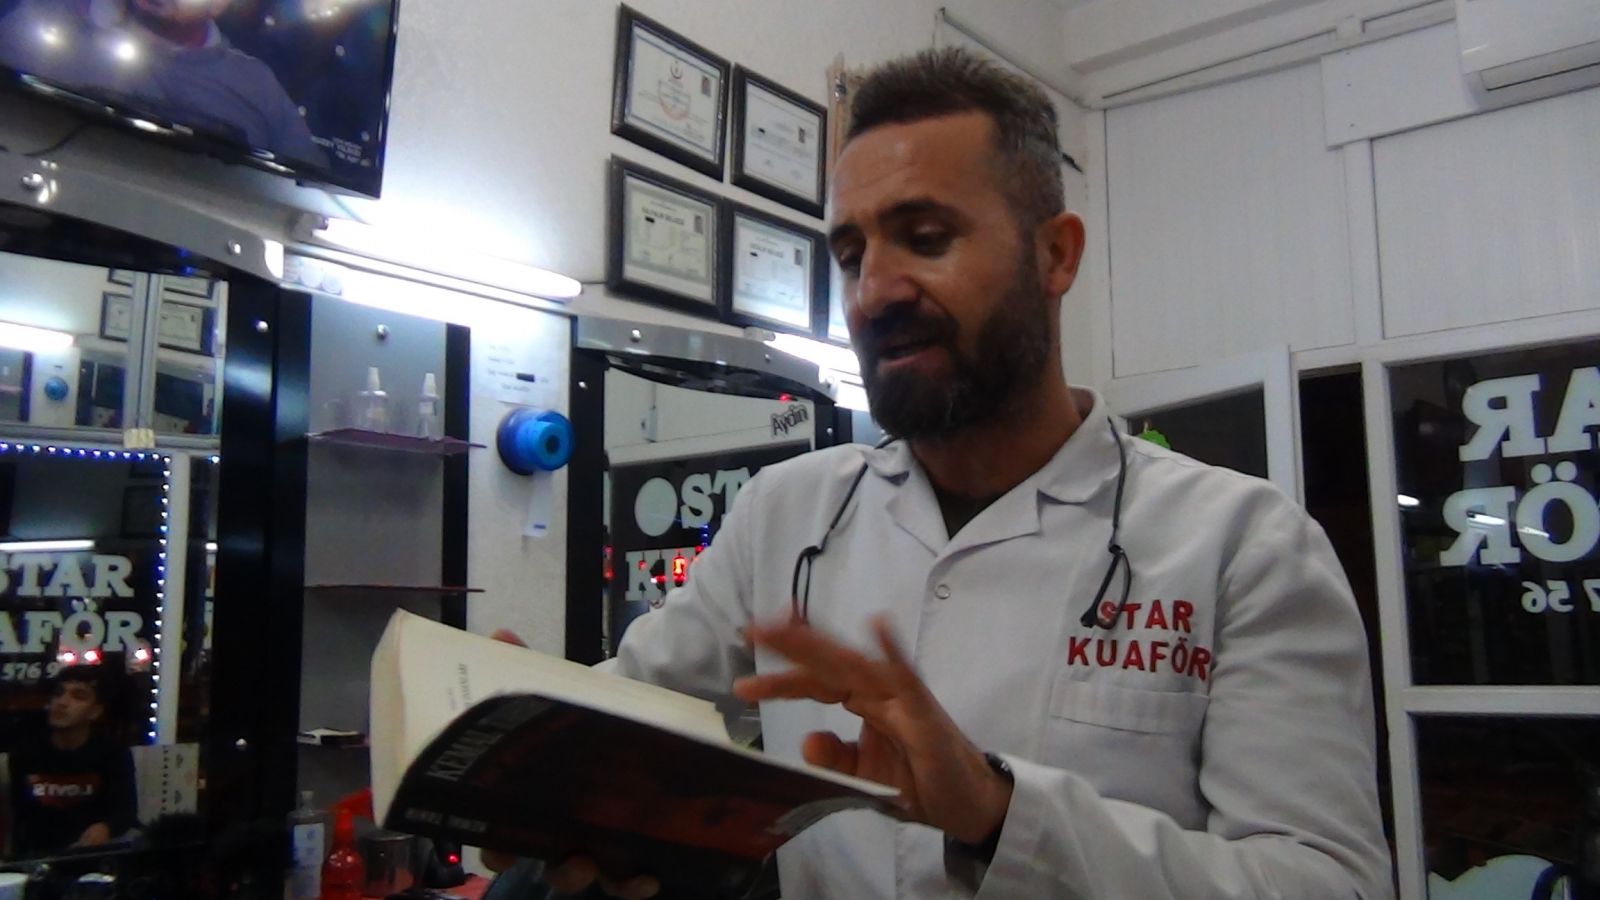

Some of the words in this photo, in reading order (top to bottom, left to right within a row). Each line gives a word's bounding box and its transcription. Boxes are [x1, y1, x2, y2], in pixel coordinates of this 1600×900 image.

[0, 552, 135, 597] TAR
[1099, 599, 1194, 633] STAR
[1067, 636, 1212, 681] KUAFÖR
